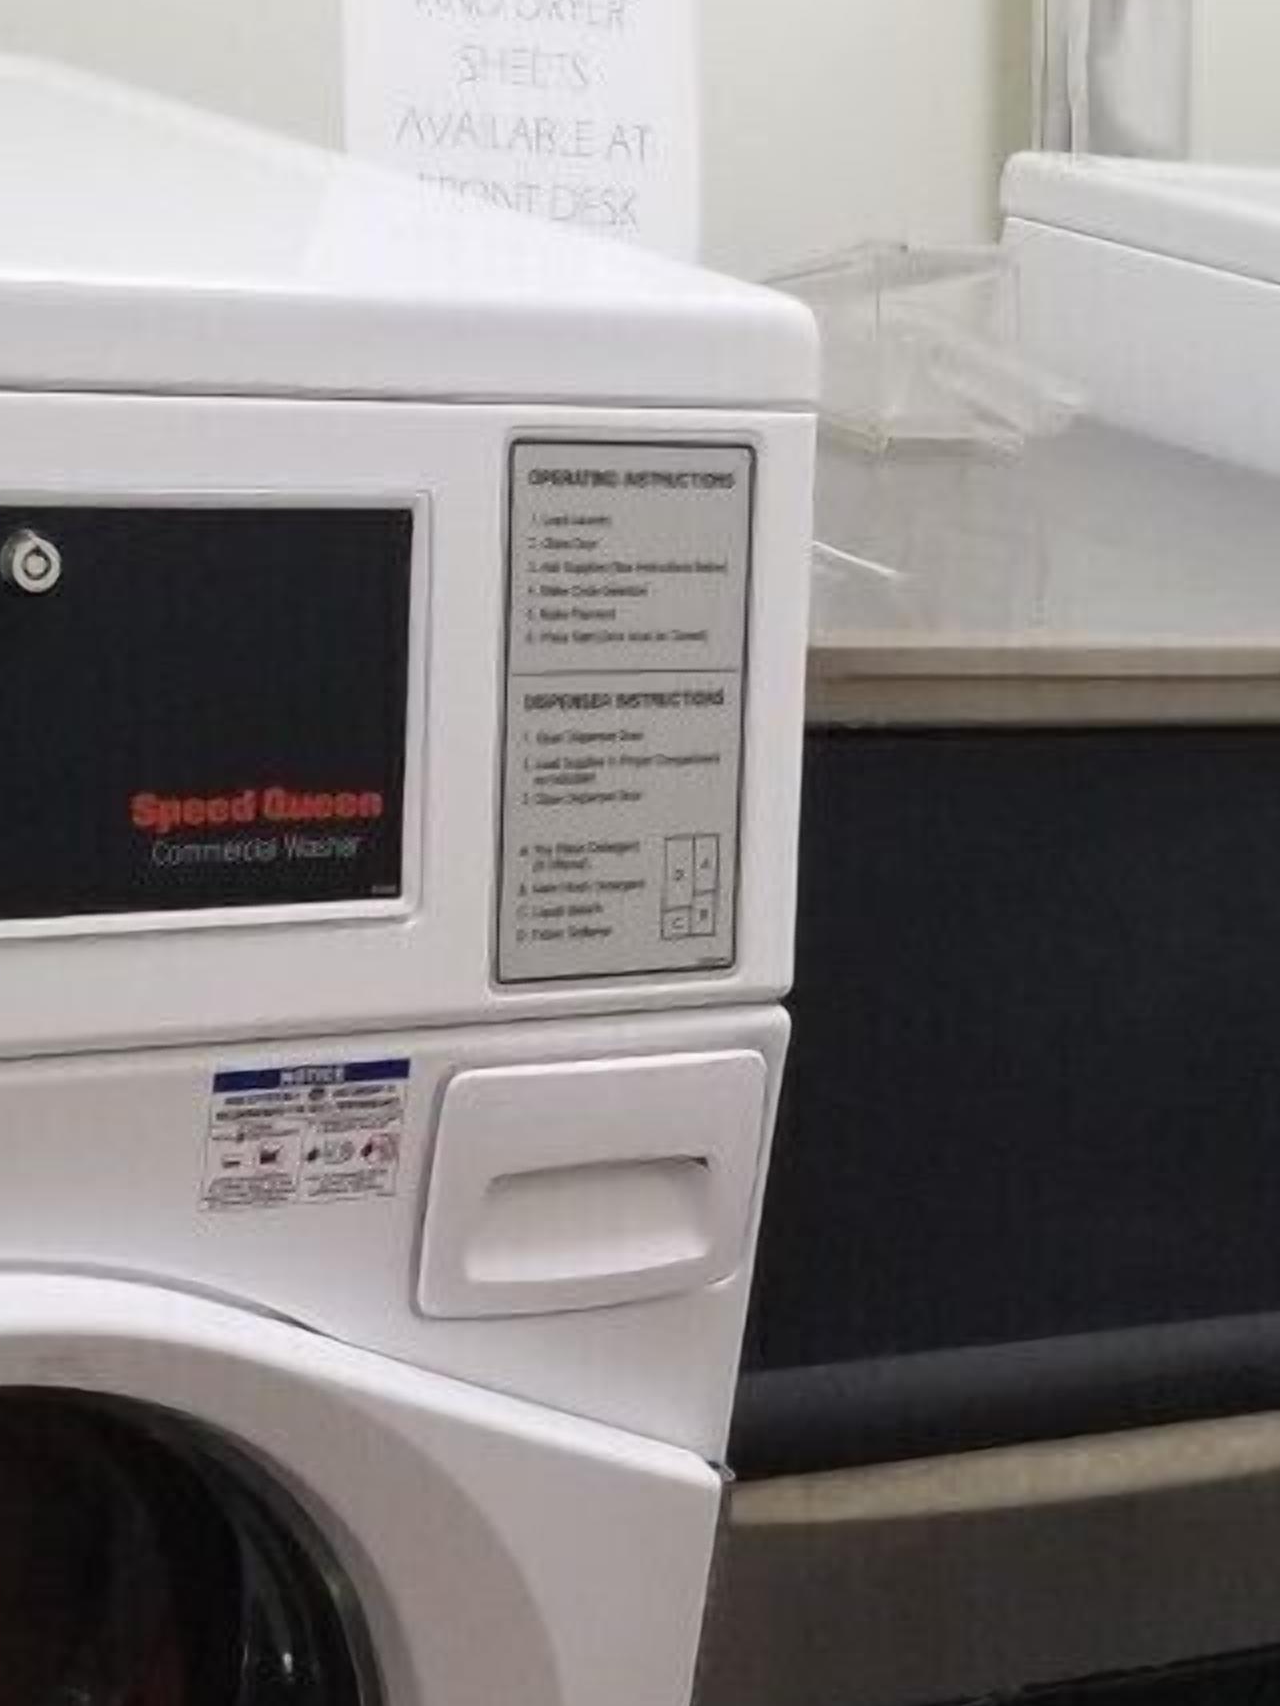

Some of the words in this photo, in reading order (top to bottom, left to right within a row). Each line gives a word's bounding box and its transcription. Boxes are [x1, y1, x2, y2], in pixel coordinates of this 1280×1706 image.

[395, 105, 594, 158] AVAILABLE
[606, 123, 650, 165] AT
[131, 790, 256, 834] Speed
[263, 787, 384, 819] Queen
